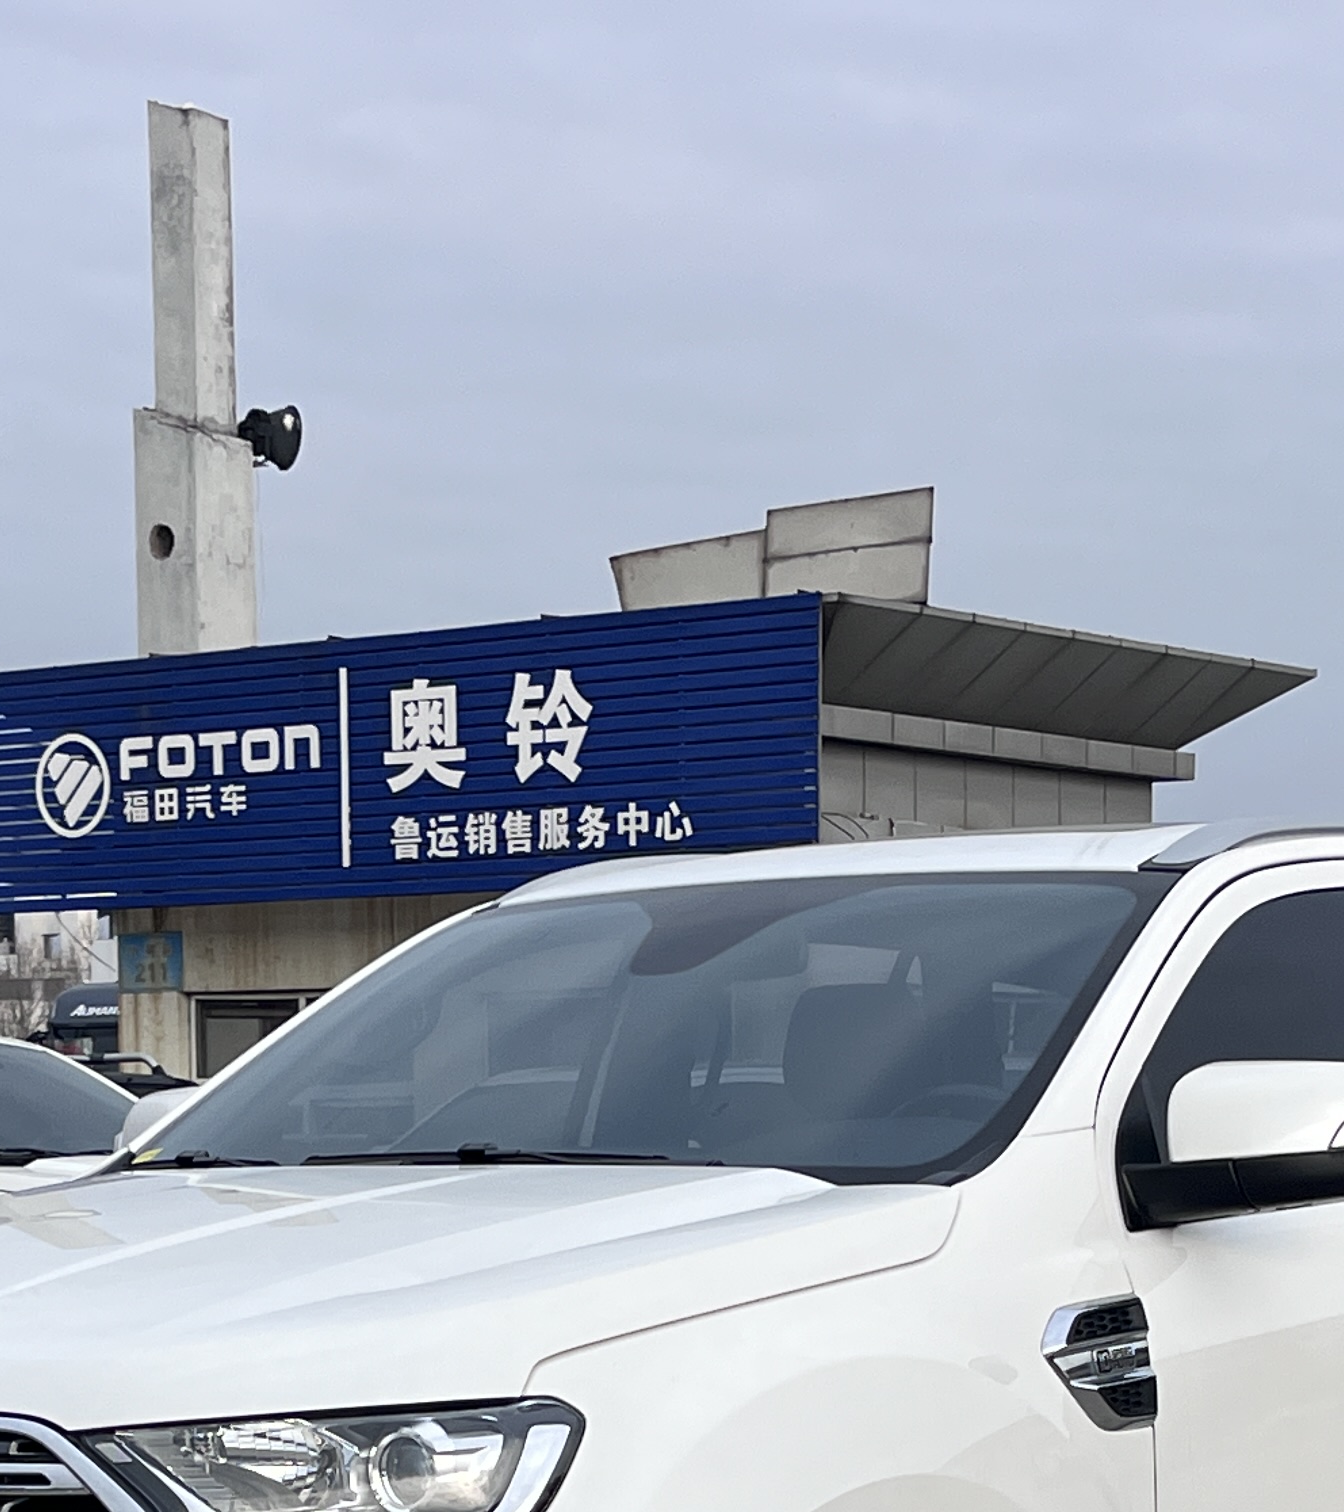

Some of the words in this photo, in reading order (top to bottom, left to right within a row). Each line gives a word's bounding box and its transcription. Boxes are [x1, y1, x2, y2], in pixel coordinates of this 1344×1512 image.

[119, 724, 321, 781] FOTON
[383, 668, 593, 794] 奥铃
[123, 784, 248, 823] 福田汽车
[390, 800, 693, 860] 鲁运销售服务中心
